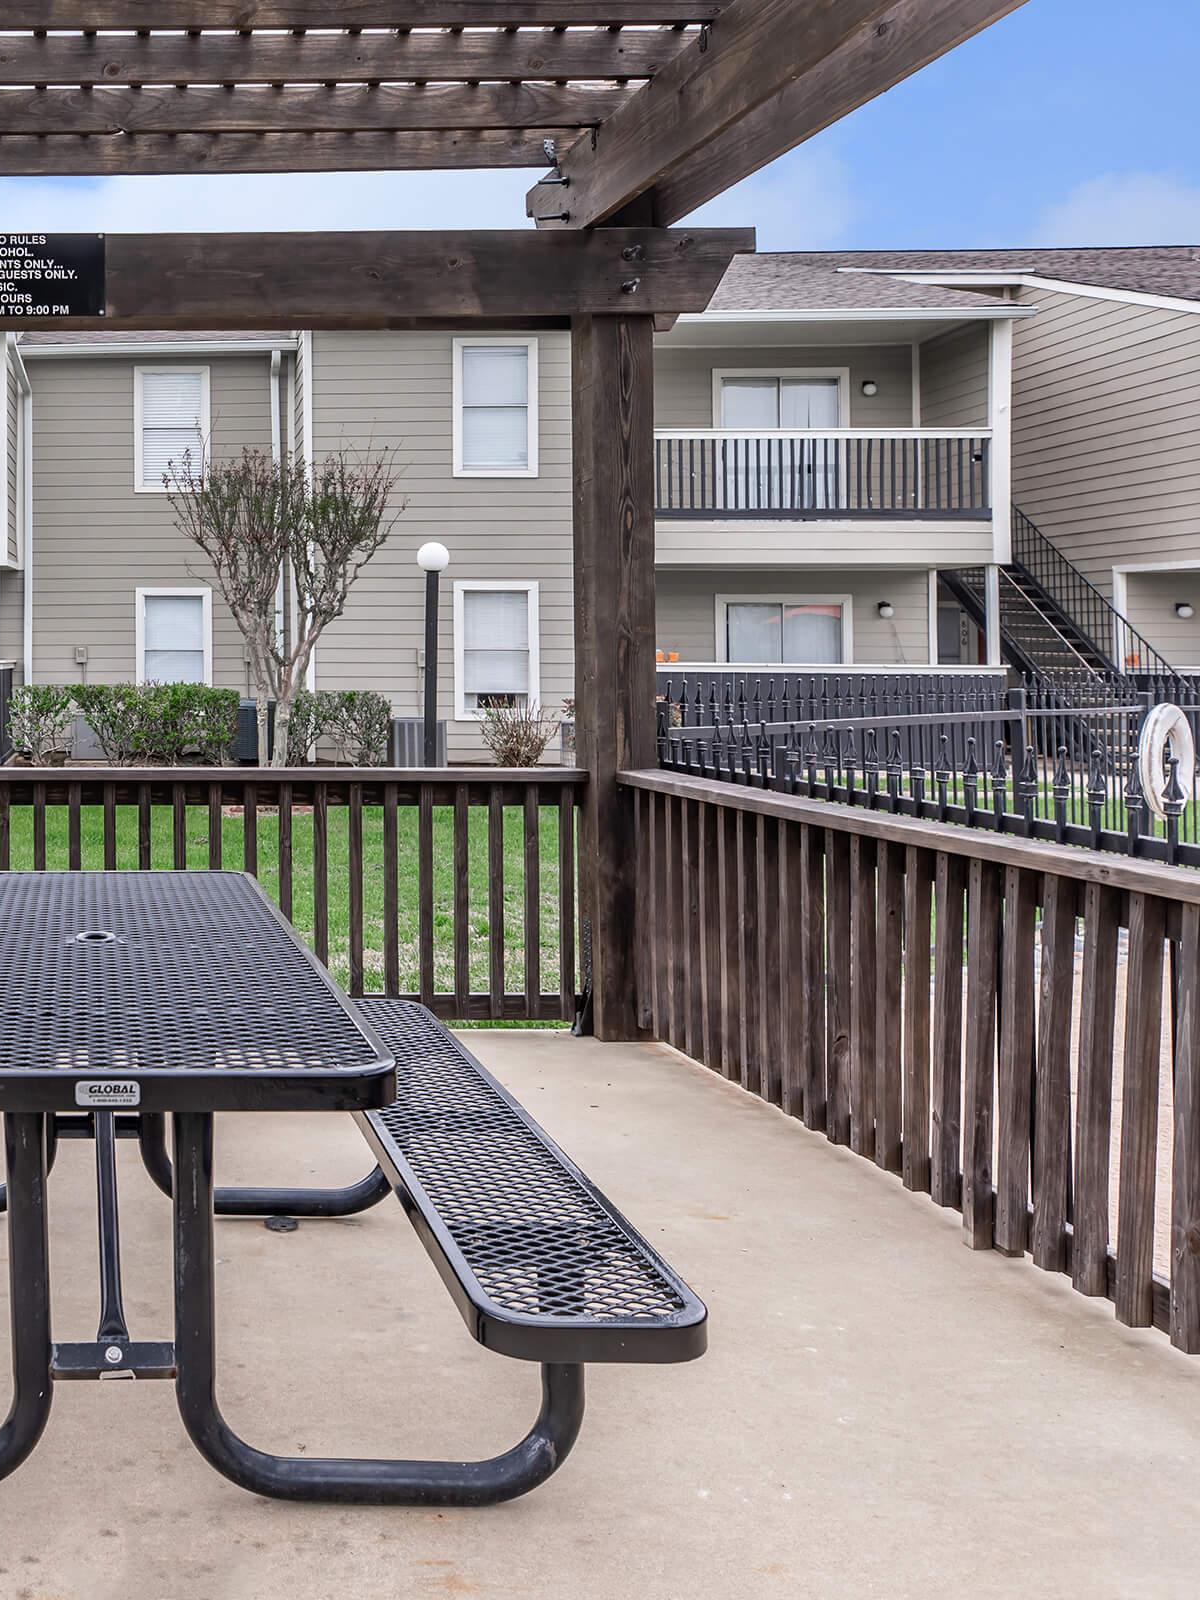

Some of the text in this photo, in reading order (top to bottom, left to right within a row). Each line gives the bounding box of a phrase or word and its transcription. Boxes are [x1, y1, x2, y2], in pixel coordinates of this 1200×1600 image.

[9, 235, 47, 245] RULES
[24, 259, 64, 269] ONLY...
[44, 270, 78, 280] ONLY.
[8, 305, 23, 315] TO
[26, 305, 50, 315] 9:00
[52, 305, 70, 315] PM
[88, 1084, 136, 1094] GLOBAL
